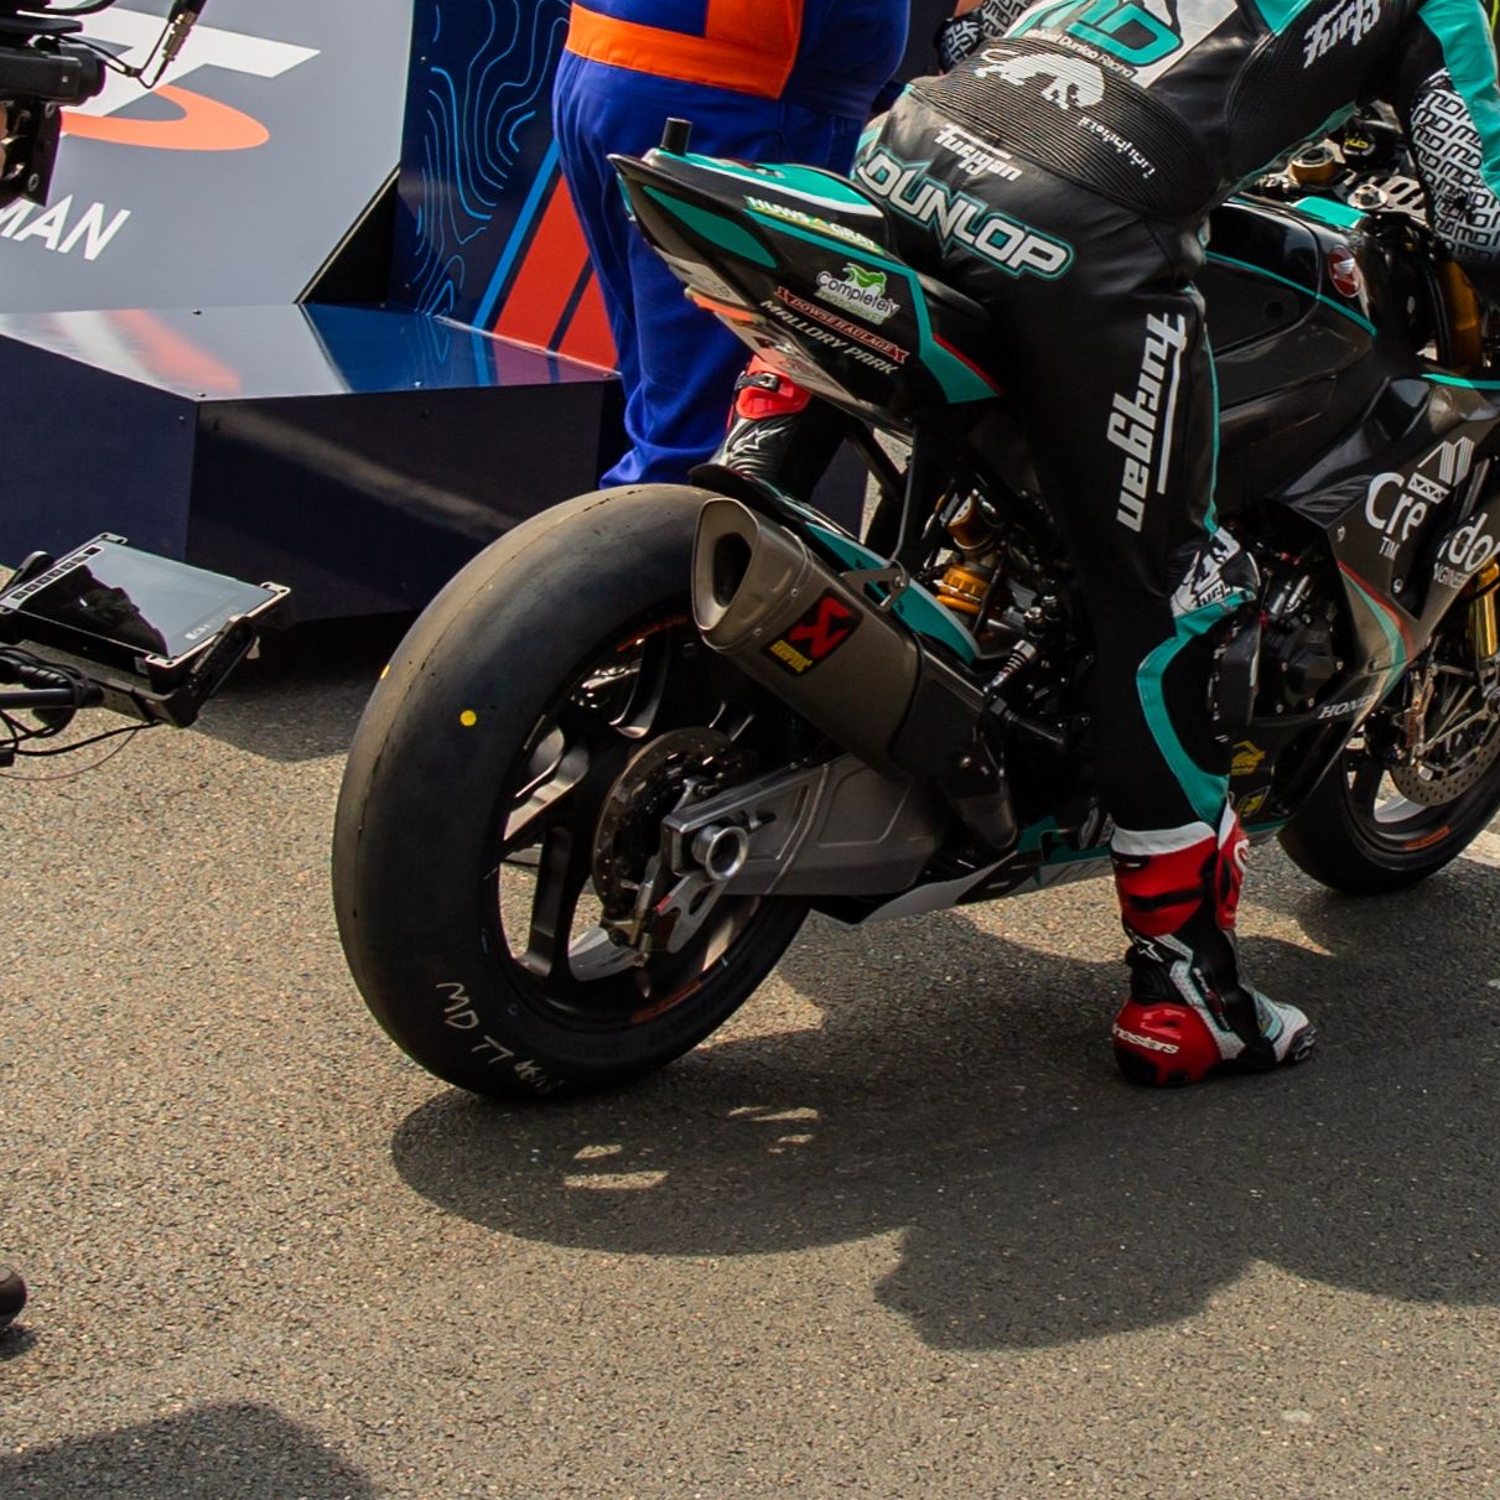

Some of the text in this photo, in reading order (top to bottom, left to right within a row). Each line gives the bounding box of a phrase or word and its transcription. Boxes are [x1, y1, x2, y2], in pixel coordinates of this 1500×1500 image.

[855, 149, 1070, 276] DUNLOP
[760, 300, 899, 376] MALLORY PARK
[815, 270, 900, 314] Completely
[1107, 313, 1187, 532] Furygan
